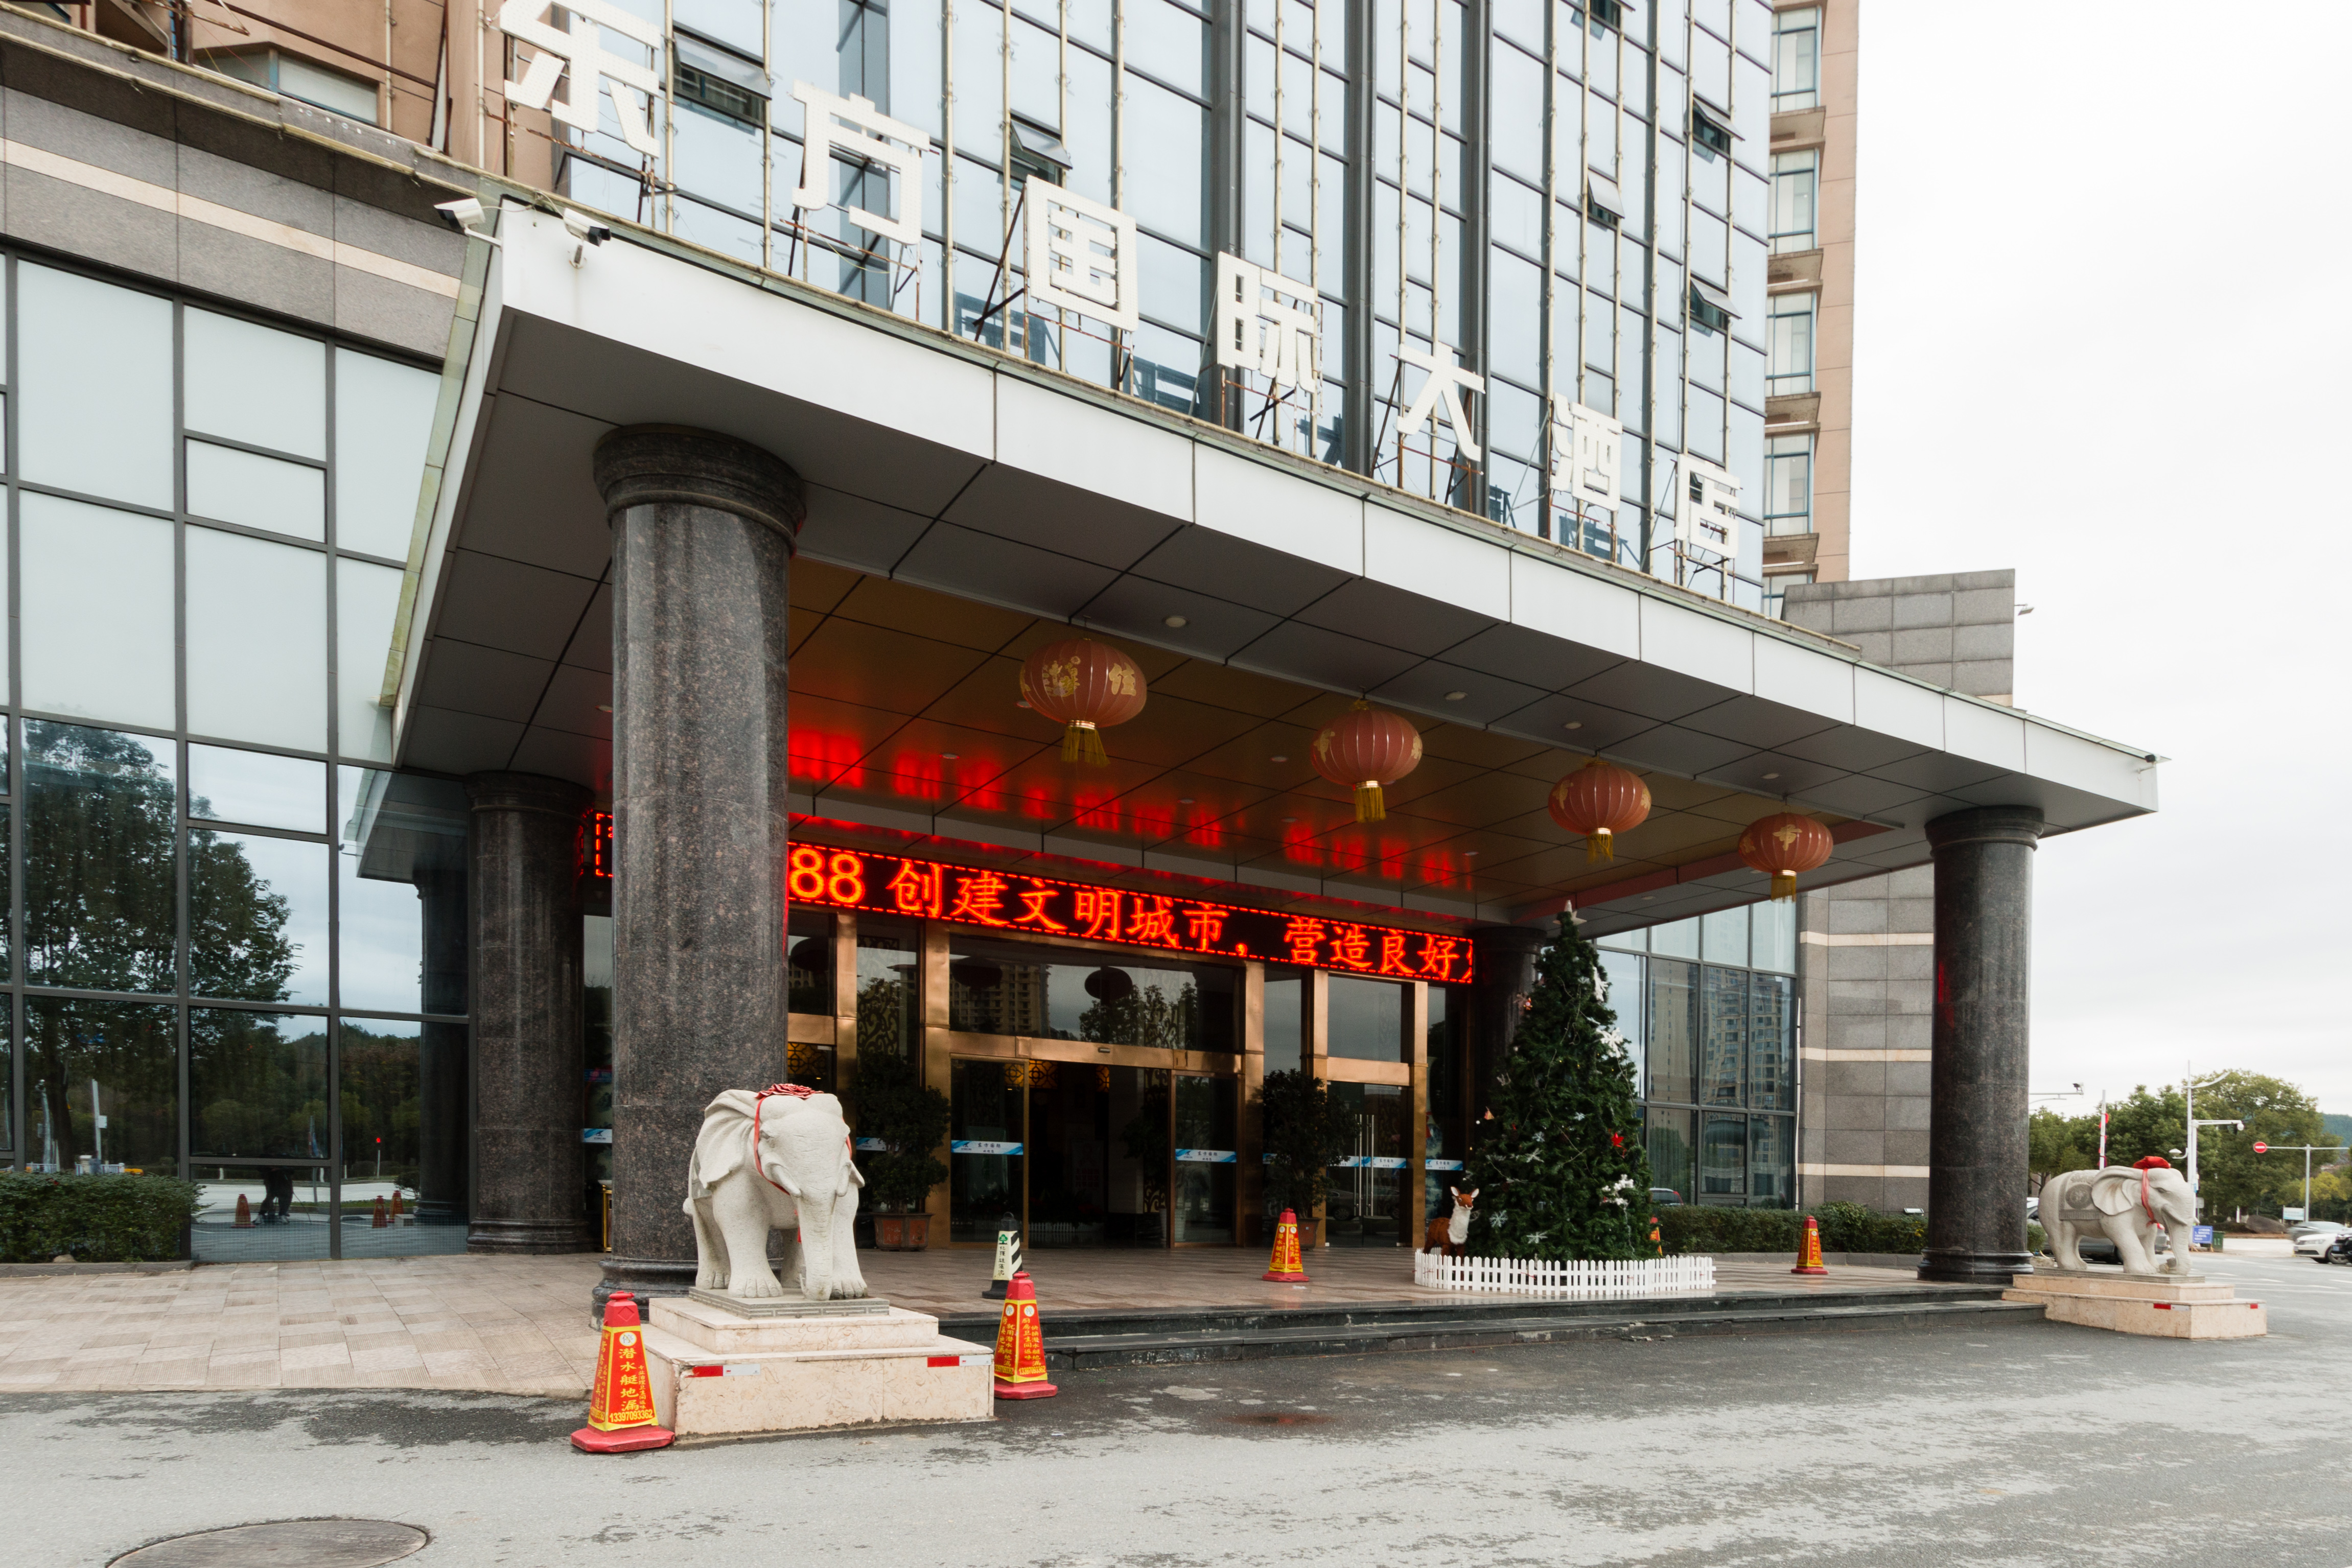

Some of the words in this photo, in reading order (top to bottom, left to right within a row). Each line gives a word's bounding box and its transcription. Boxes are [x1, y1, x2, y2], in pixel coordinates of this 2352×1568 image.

[499, 0, 1741, 559] 东方国际大酒店
[886, 858, 1474, 980] 创建文明城市，营造良好
[609, 1409, 654, 1423] 13397093362
[618, 1348, 639, 1411] 潜水艇地漏
